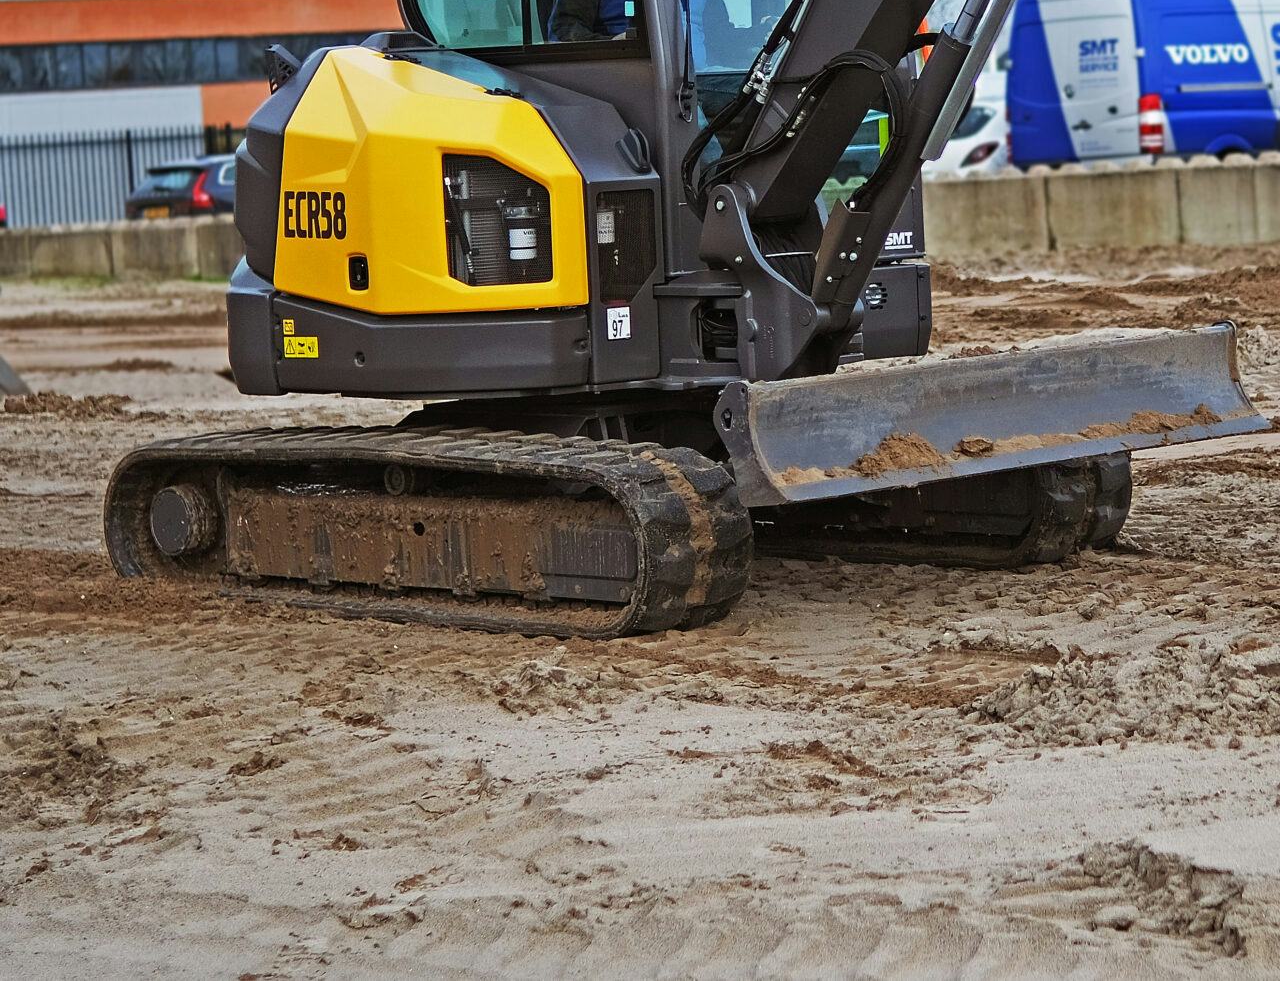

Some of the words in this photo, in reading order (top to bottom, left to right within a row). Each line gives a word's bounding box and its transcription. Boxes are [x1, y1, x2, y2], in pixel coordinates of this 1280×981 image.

[1079, 38, 1119, 56] SMT
[1164, 43, 1250, 65] VOLVO
[1079, 61, 1118, 73] SERVICE
[284, 191, 347, 240] ECR58
[885, 231, 913, 246] SMT
[612, 319, 624, 338] 97
